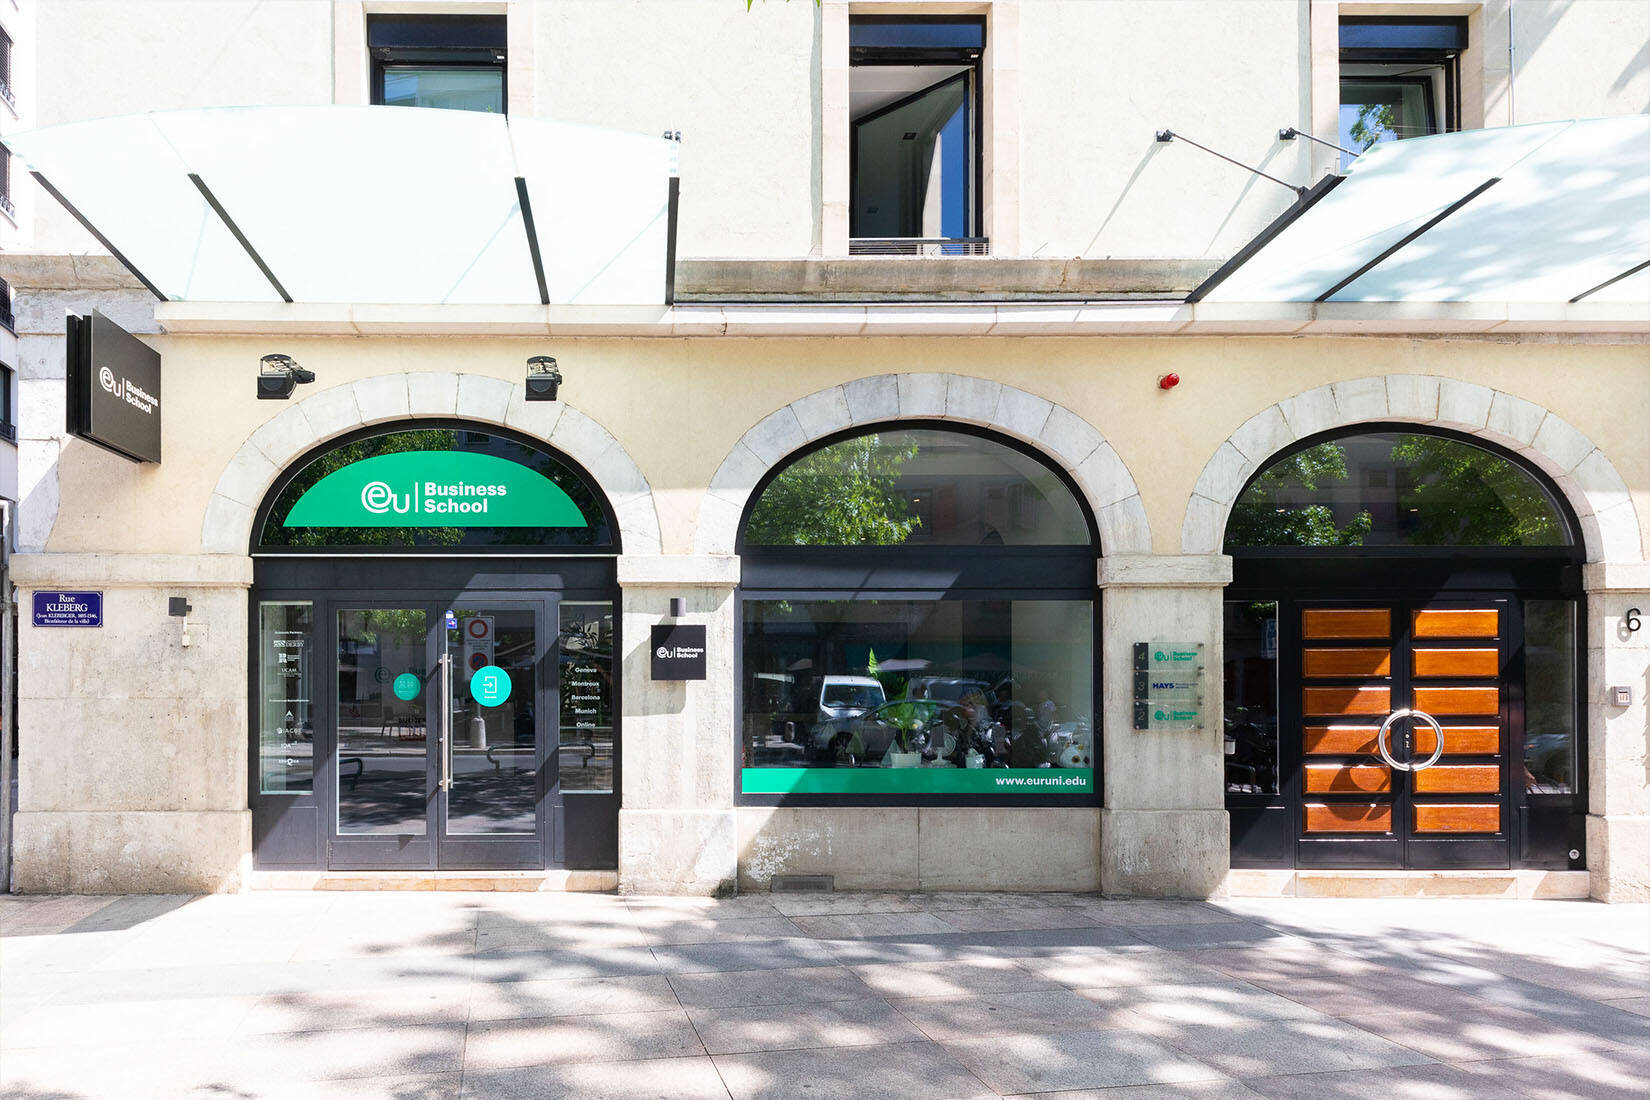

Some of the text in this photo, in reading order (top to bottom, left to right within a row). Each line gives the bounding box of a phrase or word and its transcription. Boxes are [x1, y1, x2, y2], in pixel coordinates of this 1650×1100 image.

[126, 380, 158, 407] Business
[126, 393, 151, 414] School
[361, 481, 507, 514] eu Business
[424, 498, 488, 513] School
[59, 594, 76, 602] Rue
[46, 603, 88, 612] KLEBERG
[1627, 608, 1641, 632] 6
[995, 776, 1086, 786] www.euruni.edu
